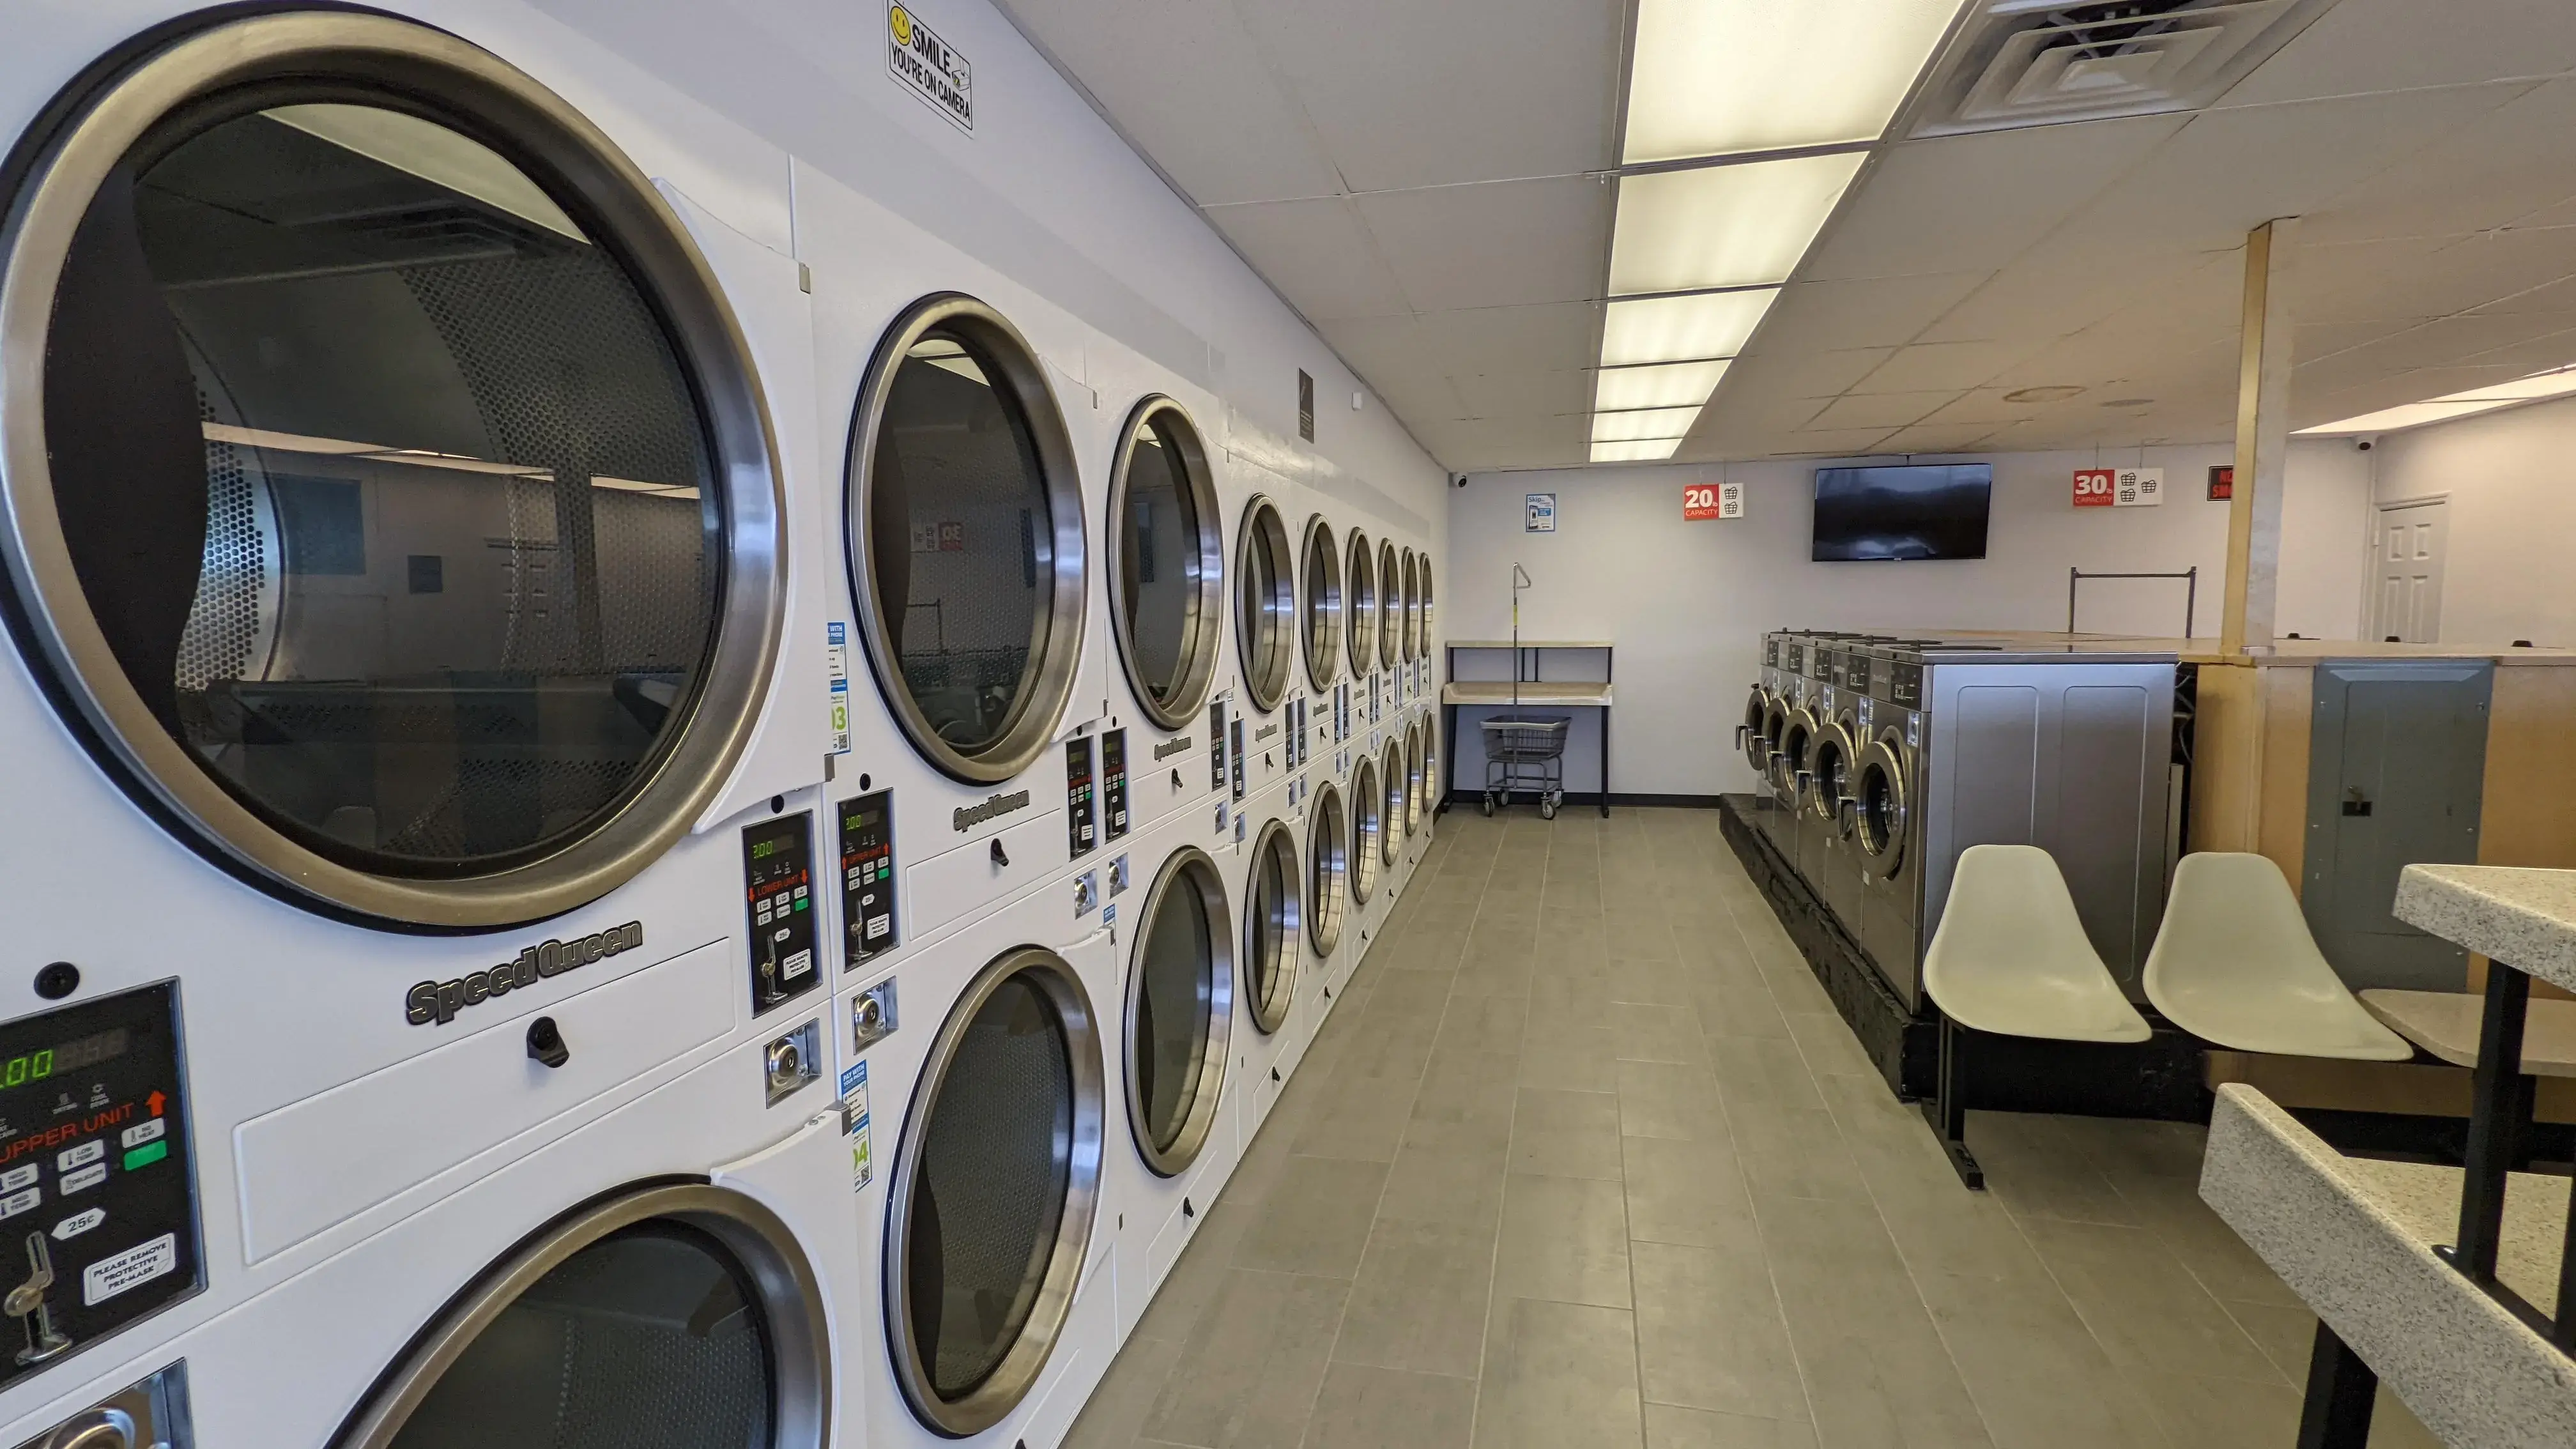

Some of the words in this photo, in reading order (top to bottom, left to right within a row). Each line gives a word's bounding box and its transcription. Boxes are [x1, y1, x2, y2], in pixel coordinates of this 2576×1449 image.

[912, 24, 951, 78] SMILE
[891, 42, 923, 84] YOU'RE
[924, 69, 936, 95] ON
[939, 79, 970, 121] CAMERA
[2075, 475, 2107, 494] 30
[1685, 489, 1713, 509] 20
[843, 1071, 852, 1082] PAY
[84, 1102, 135, 1131] UNIT
[93, 1259, 127, 1277] PLEASE
[130, 1242, 167, 1262] REMOVE
[103, 1255, 158, 1283] PROTECTIVE
[107, 1265, 154, 1290] PRE-MASK
